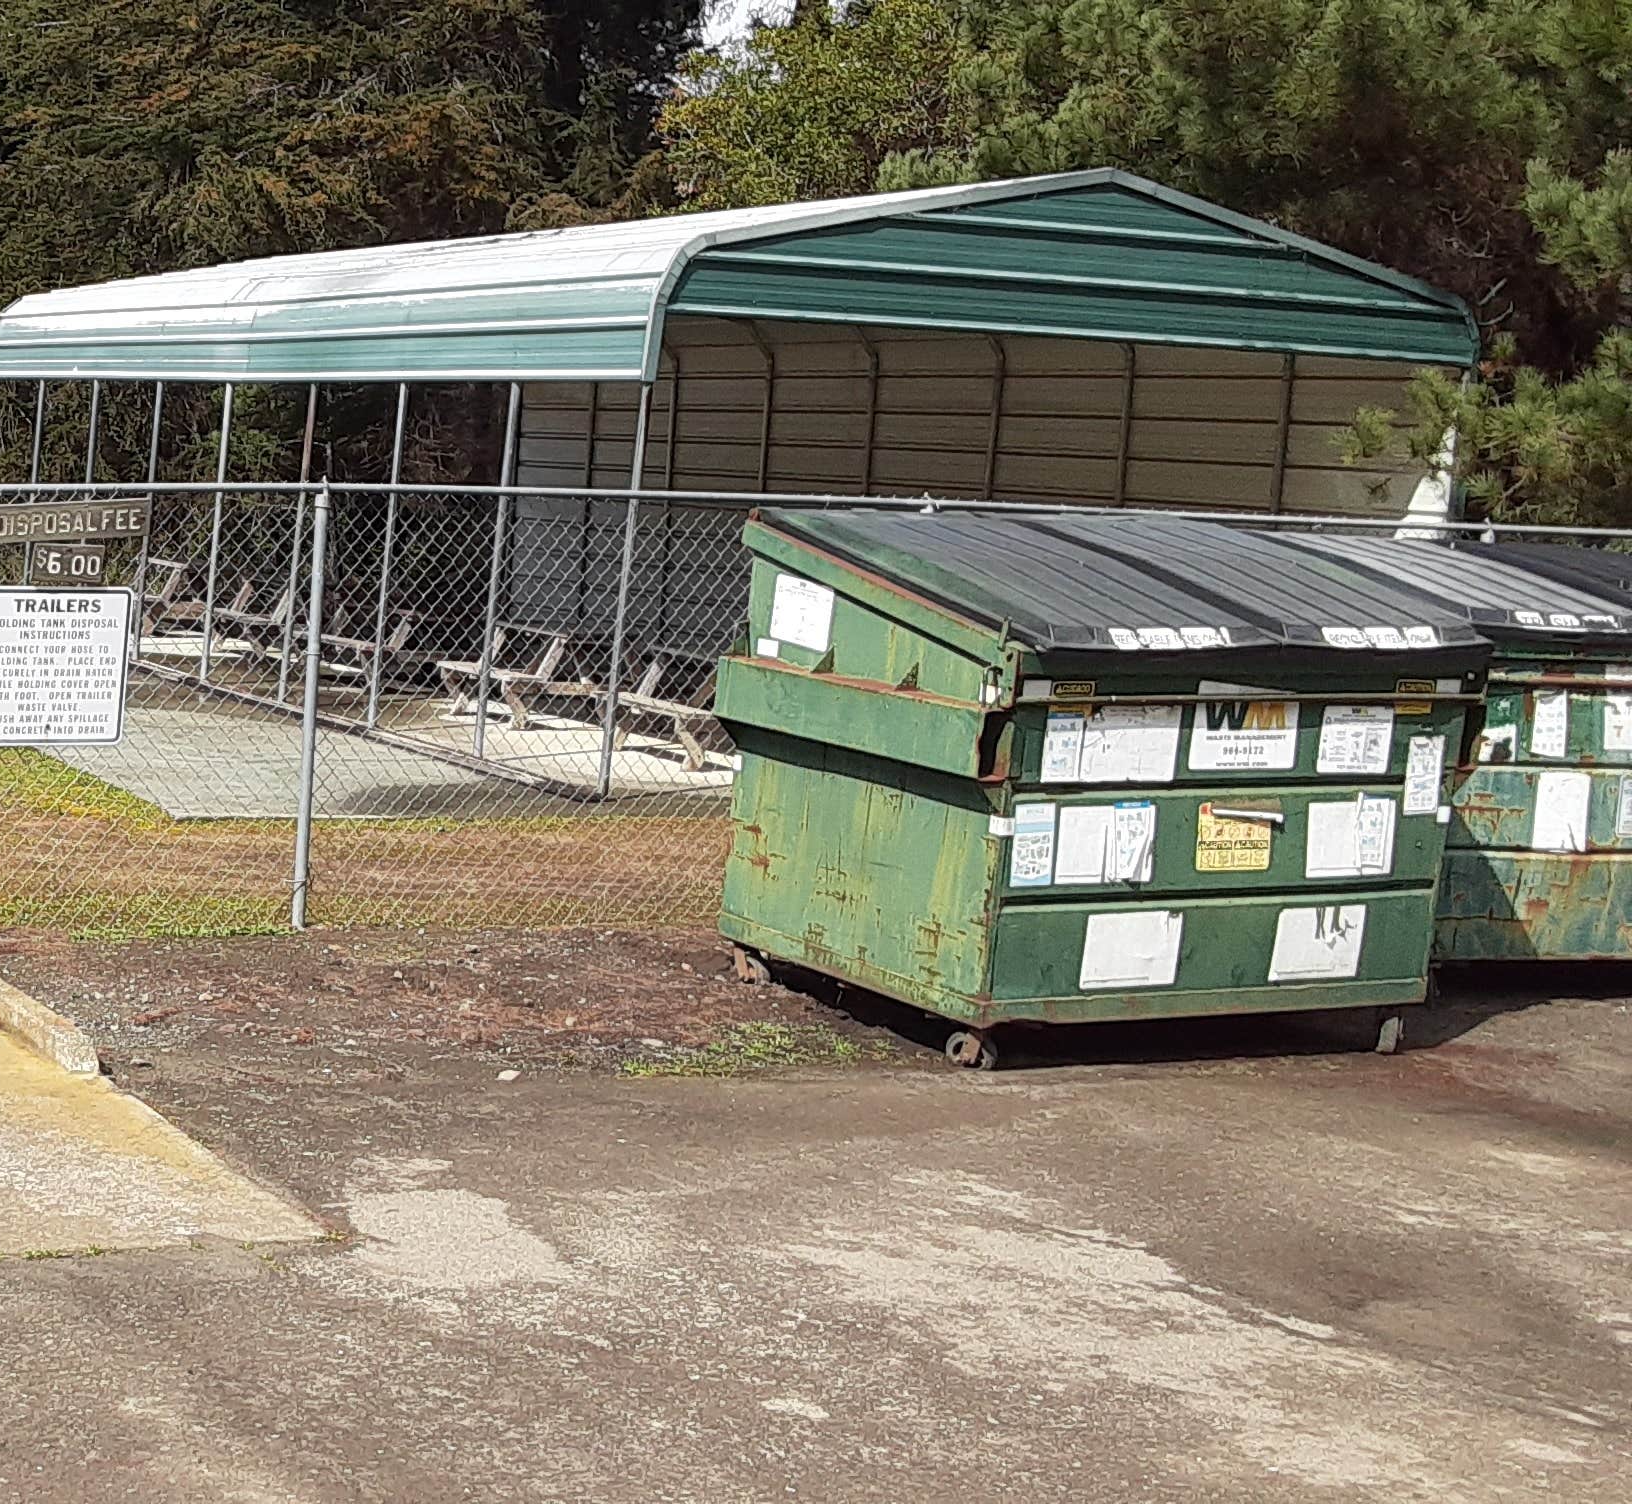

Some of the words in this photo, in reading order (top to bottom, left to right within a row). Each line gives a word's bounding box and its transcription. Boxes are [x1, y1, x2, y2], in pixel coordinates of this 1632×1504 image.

[101, 508, 142, 531] FEE
[36, 547, 101, 576] $6.00
[13, 598, 102, 613] TRAILERS
[40, 618, 66, 628] TANK
[71, 618, 119, 628] DISPOSAL
[19, 630, 91, 640] INSTRUCTIONS
[43, 645, 65, 654] YOUR
[71, 645, 95, 654] HOSE
[99, 645, 109, 654] TO
[68, 657, 94, 666] PLACE
[99, 657, 117, 666] END
[39, 669, 49, 678] IN
[54, 669, 81, 678] DRAIN
[85, 669, 113, 677] HATCH
[17, 680, 56, 689] HOLDING
[61, 680, 89, 689] COVER
[94, 680, 117, 689] OPEN
[48, 692, 72, 701] OPEN
[76, 691, 112, 700] TRAILER
[17, 703, 47, 712] WASTE
[19, 714, 43, 723] AWAY
[47, 714, 64, 723] ANY
[68, 714, 109, 723] SPILLAGE
[1206, 700, 1286, 730] WM
[3, 726, 49, 735] CONCRETE
[53, 726, 73, 735] INTO
